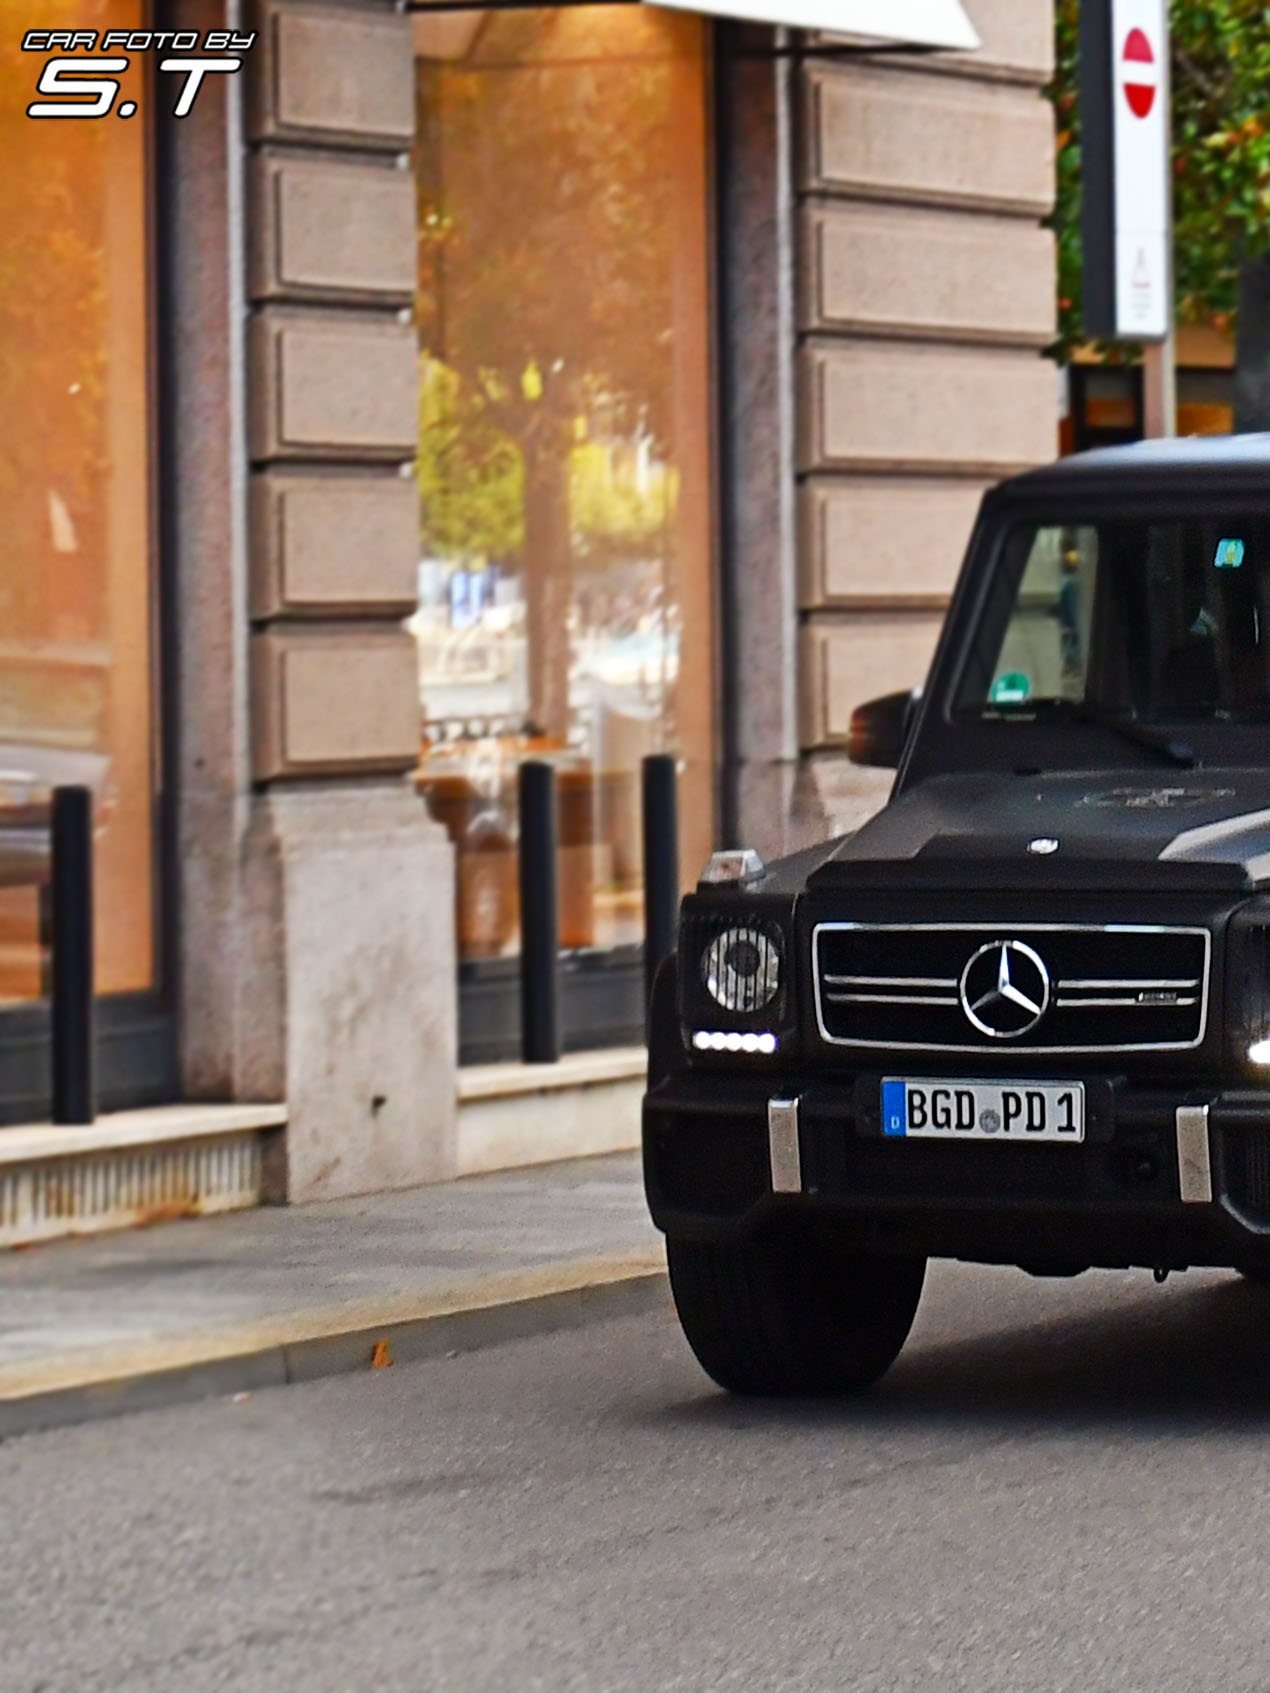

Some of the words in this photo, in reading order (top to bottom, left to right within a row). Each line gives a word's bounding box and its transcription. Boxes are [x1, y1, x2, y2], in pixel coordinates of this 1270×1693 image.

[890, 1116, 900, 1130] D
[907, 1089, 976, 1131] BGD
[1001, 1091, 1046, 1132] PD
[1057, 1092, 1077, 1133] 1
